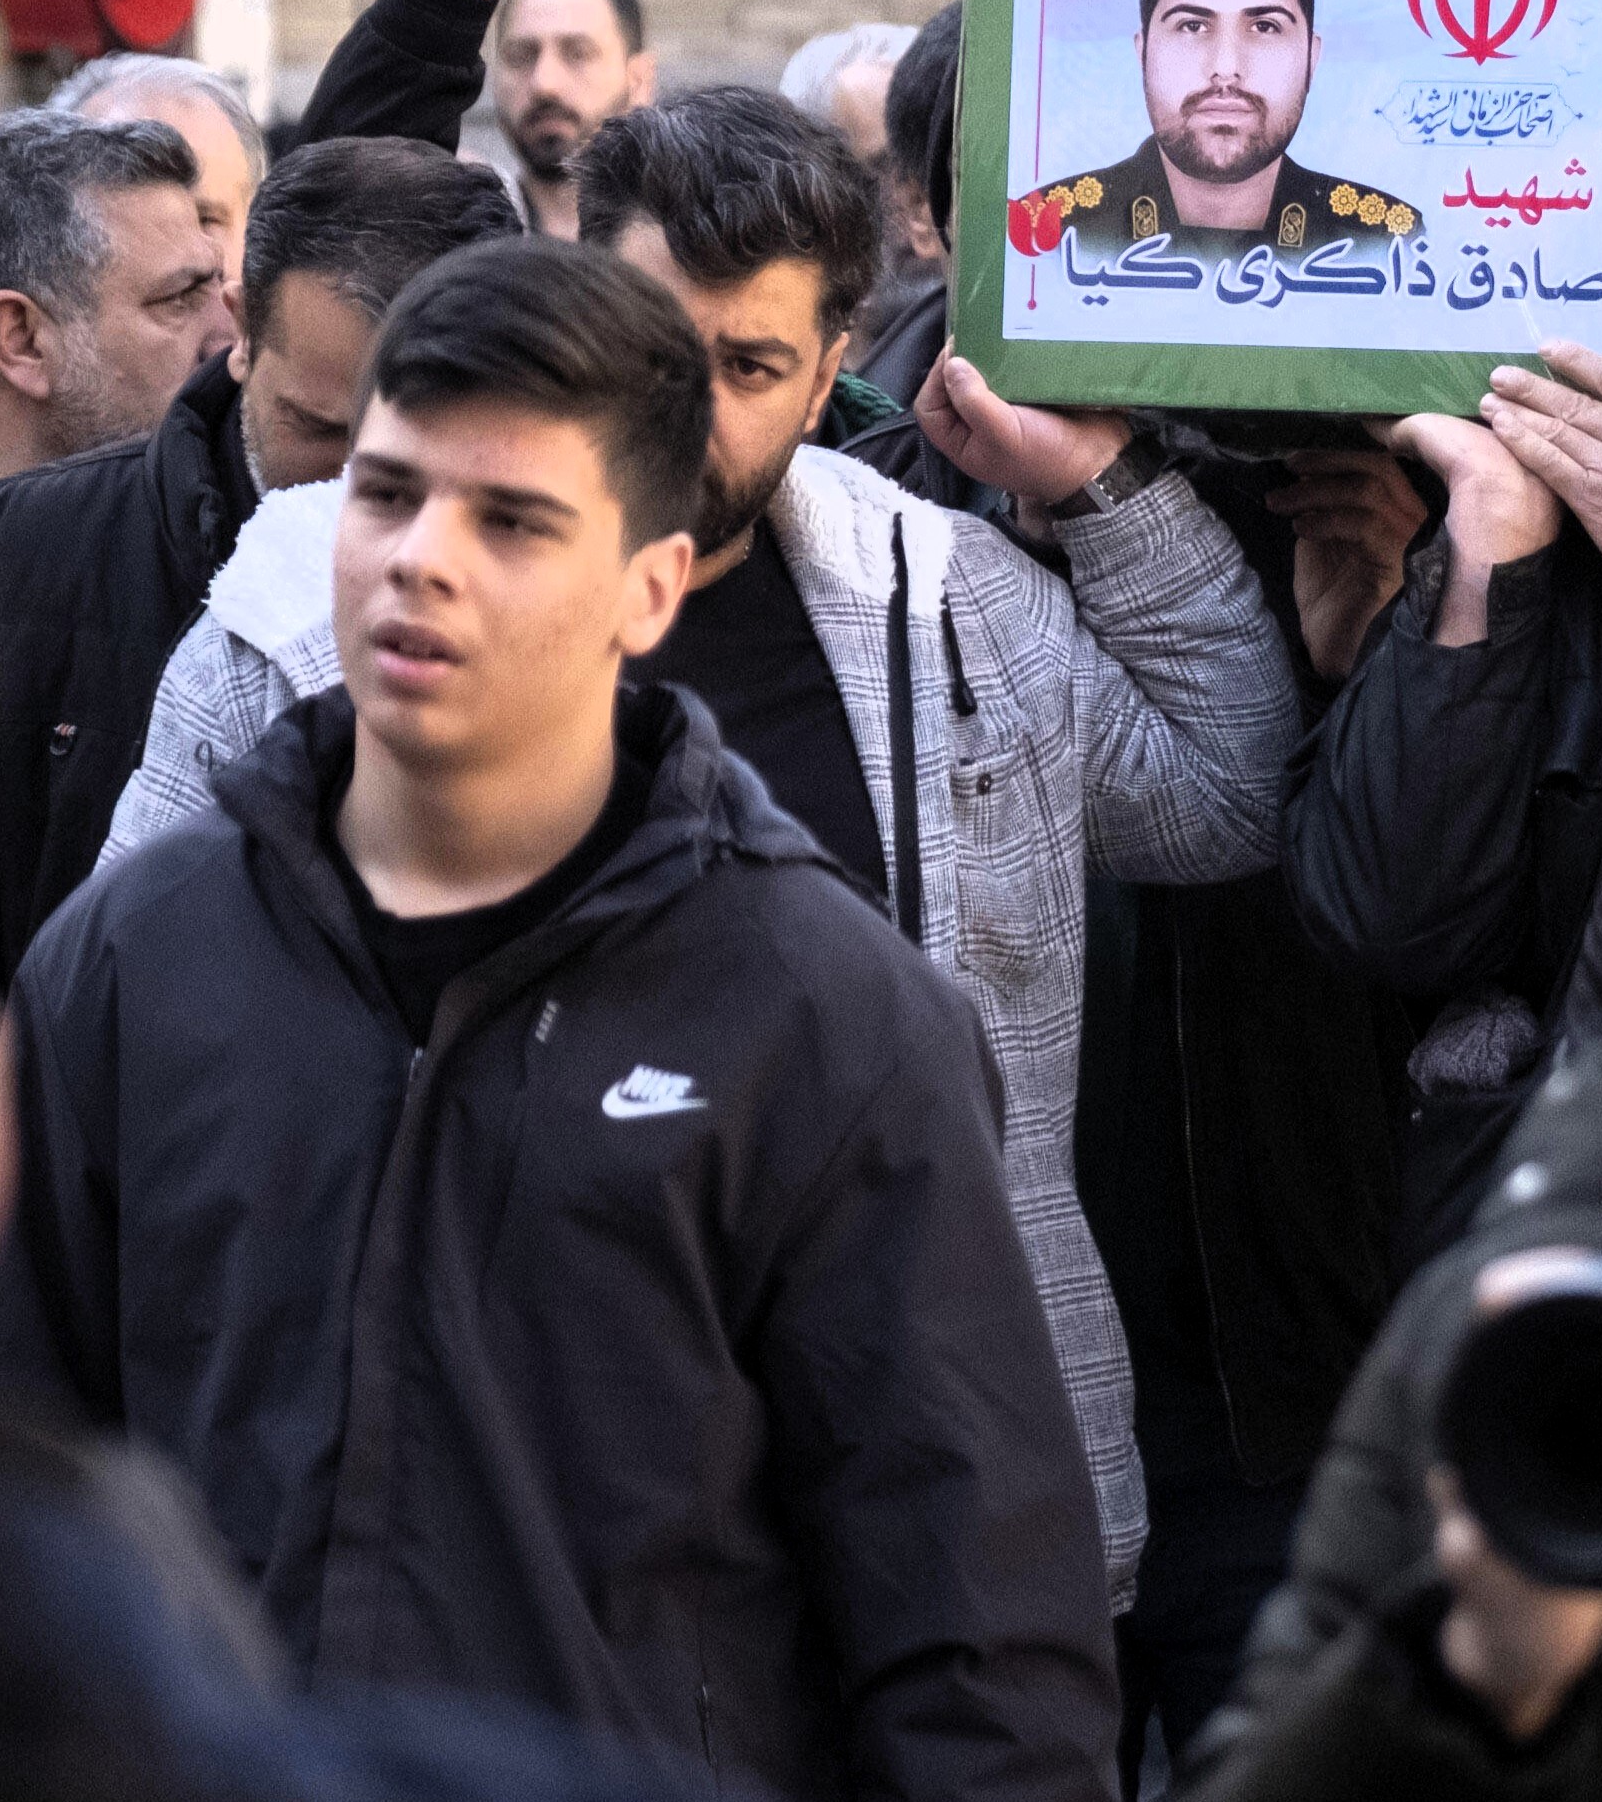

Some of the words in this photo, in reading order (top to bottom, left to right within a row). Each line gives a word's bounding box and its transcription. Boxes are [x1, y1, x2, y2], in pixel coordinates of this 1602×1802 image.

[1442, 159, 1594, 227] شهید
[1065, 228, 1202, 306] کیا
[1216, 237, 1436, 308] ذاکری
[621, 1064, 693, 1102] NIKE
